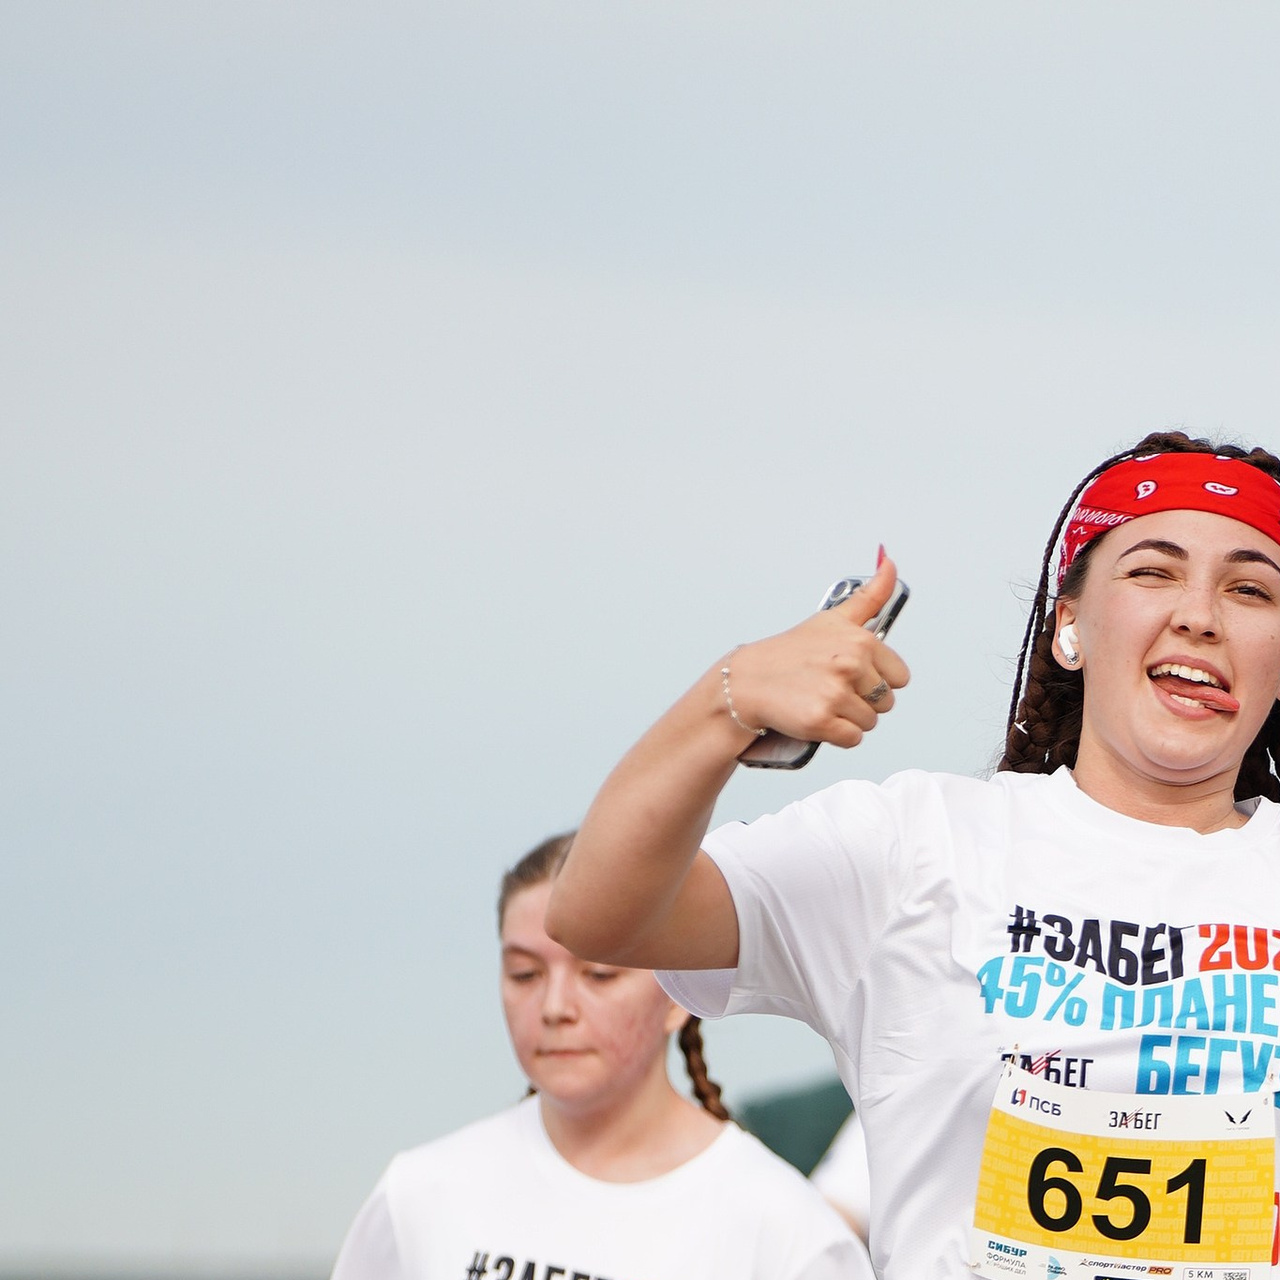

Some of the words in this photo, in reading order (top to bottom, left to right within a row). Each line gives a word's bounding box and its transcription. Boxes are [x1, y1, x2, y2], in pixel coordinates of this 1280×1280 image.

[1007, 904, 1194, 985] #ЗАБЕГ
[976, 956, 1088, 1027] 45%
[1029, 1096, 1062, 1116] ПСБ
[1108, 1109, 1162, 1130] ЗАБЕГ
[1028, 1147, 1207, 1244] 651
[988, 1240, 1028, 1258] СИБУР
[986, 1252, 1026, 1268] ФОРМУЛА
[1148, 1266, 1172, 1275] PRO
[1188, 1270, 1194, 1278] 5
